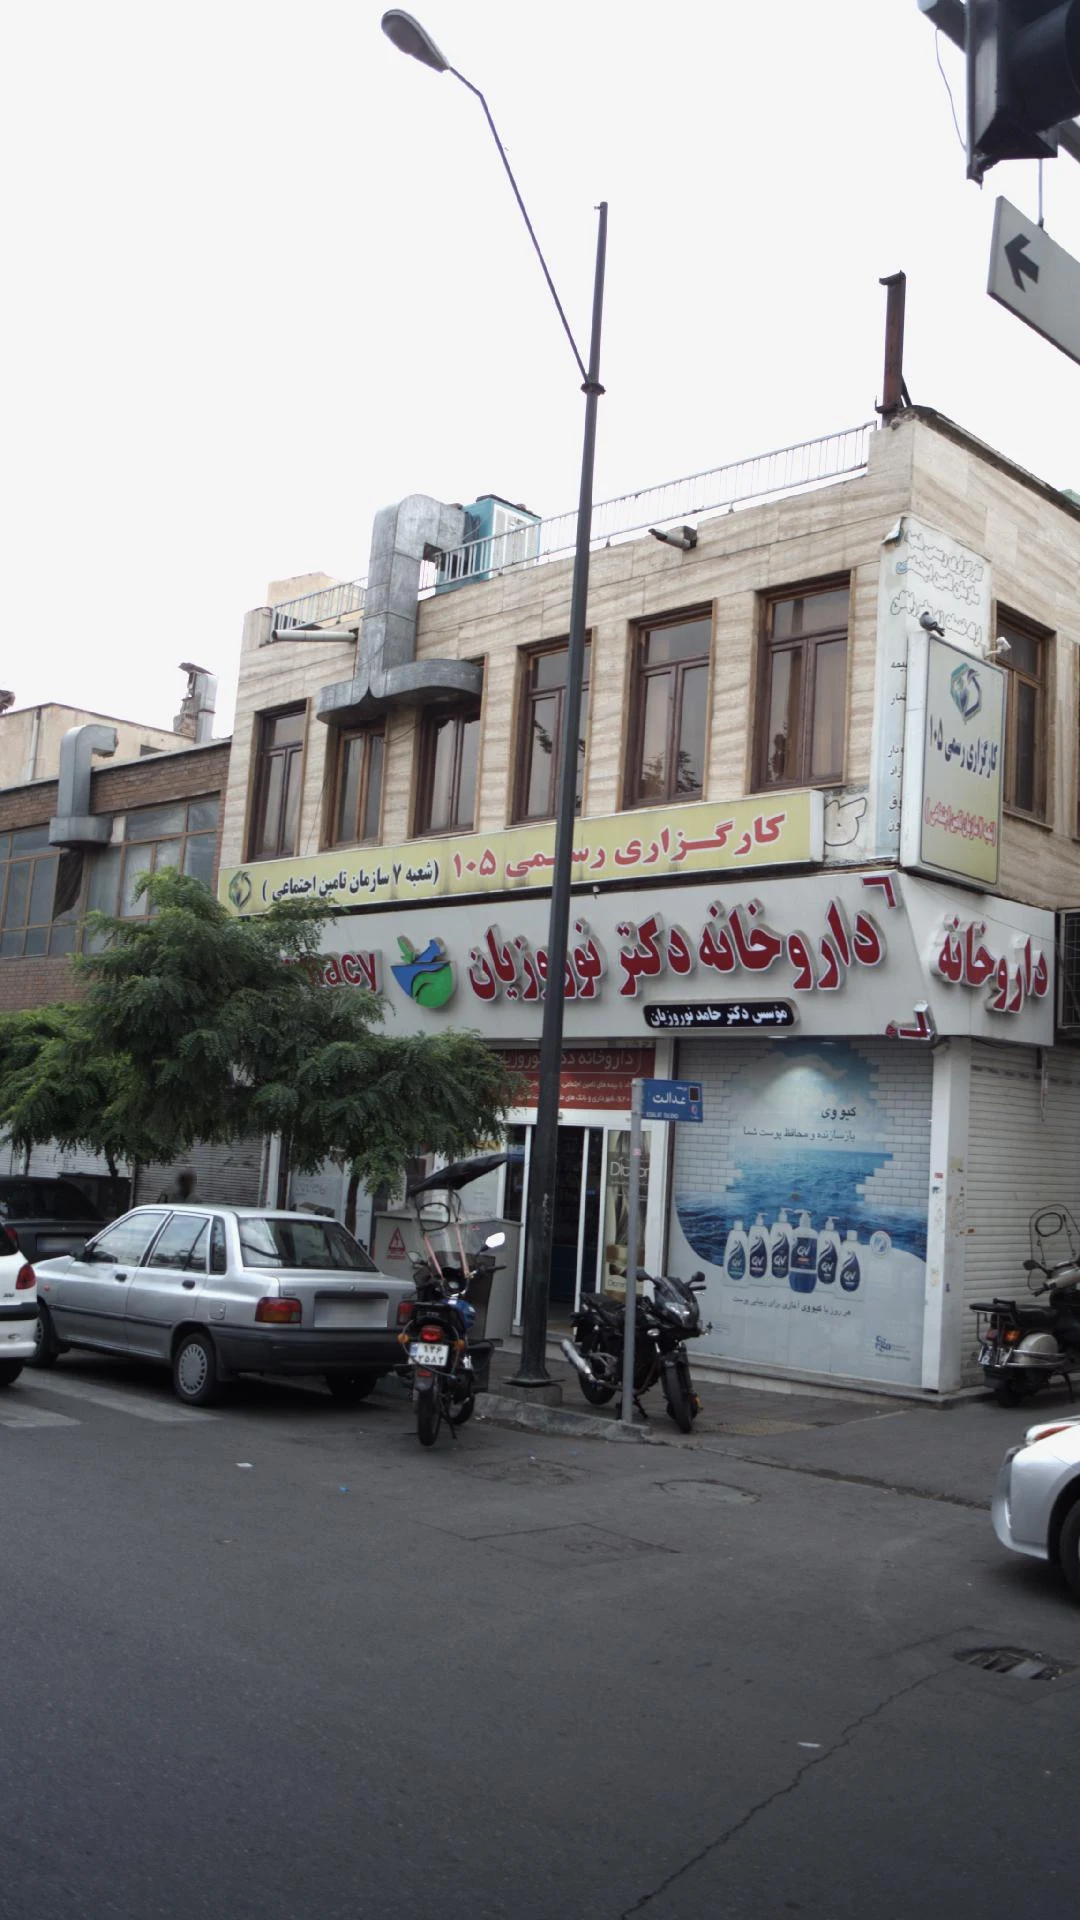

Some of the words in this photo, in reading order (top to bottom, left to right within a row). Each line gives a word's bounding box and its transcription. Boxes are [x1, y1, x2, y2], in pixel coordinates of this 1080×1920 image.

[929, 714, 944, 752] ۱۰۵
[944, 737, 966, 769] رسمی
[967, 736, 998, 779] کارگزاری
[614, 814, 786, 866] کارگزاری
[392, 863, 402, 879] ۷
[453, 848, 498, 880] ۱۰۵
[505, 844, 606, 879] رسمی
[272, 874, 317, 902] اجتماعی
[318, 870, 348, 897] تامین
[349, 867, 390, 893] سازمان
[616, 911, 692, 998] دکتر
[699, 897, 884, 991] داروخانه
[937, 912, 1050, 1014] داروخانه
[650, 1007, 694, 1026] نوروزیان
[695, 1006, 722, 1021] حامد
[726, 1005, 749, 1025] دکتر
[578, 1050, 634, 1070] داروخانه
[652, 1091, 686, 1105] عدالت
[752, 1255, 764, 1267] QV
[773, 1255, 787, 1266] QV
[797, 1246, 810, 1257] QV
[821, 1261, 833, 1273] QV
[844, 1270, 856, 1281] QV
